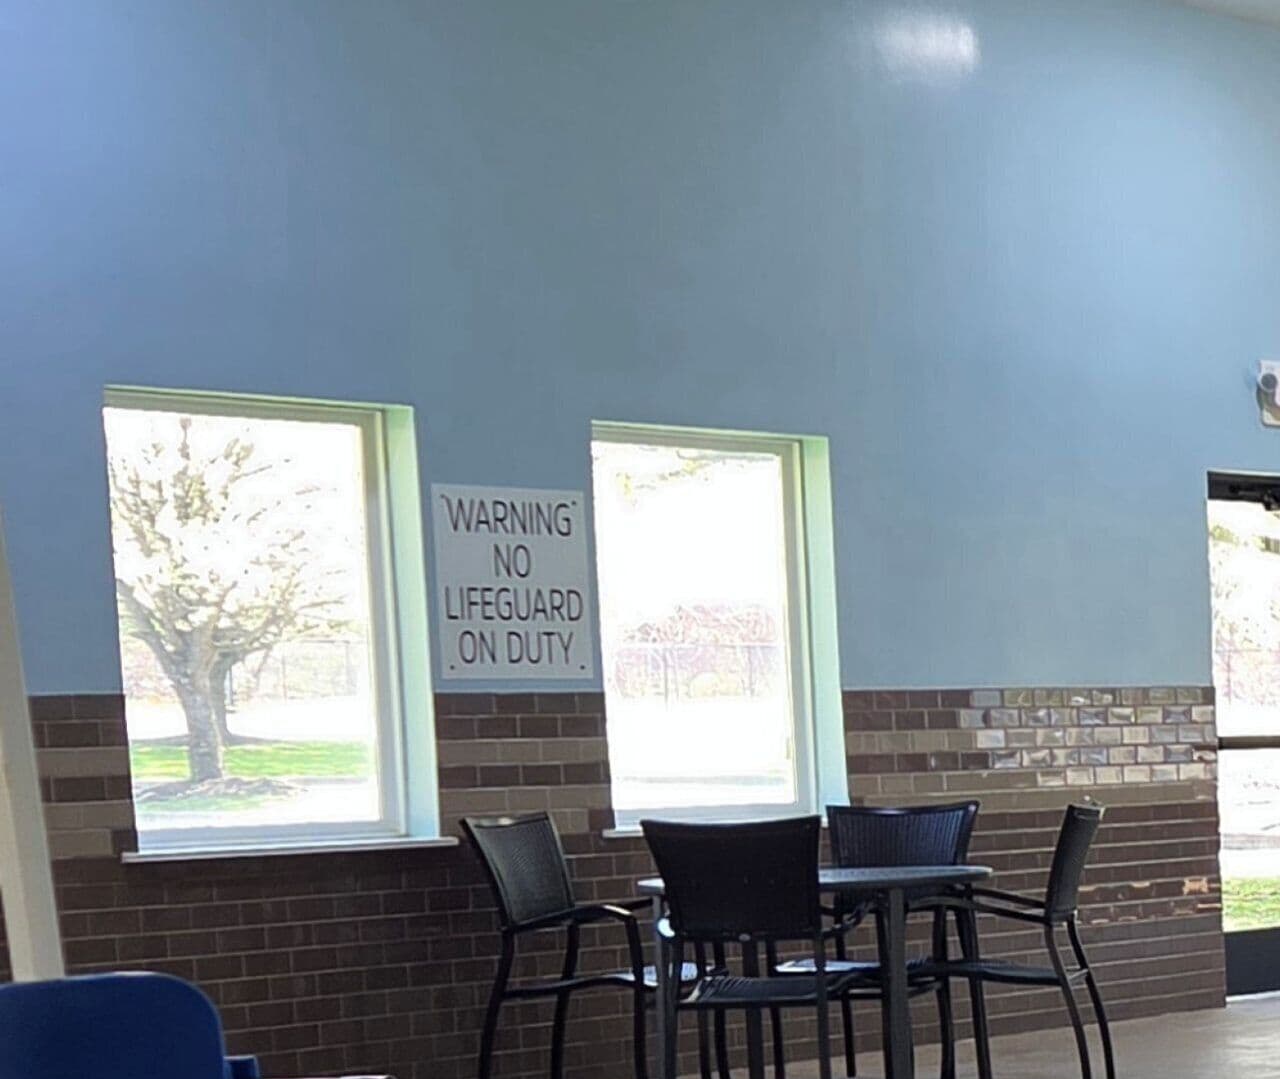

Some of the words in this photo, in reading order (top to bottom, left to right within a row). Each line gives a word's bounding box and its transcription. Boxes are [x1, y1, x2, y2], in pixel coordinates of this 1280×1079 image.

[445, 497, 573, 537] WARNING
[493, 543, 532, 578] NO
[445, 586, 584, 622] LIFEGUARD
[458, 630, 497, 664] ON
[506, 631, 574, 664] DUTY
